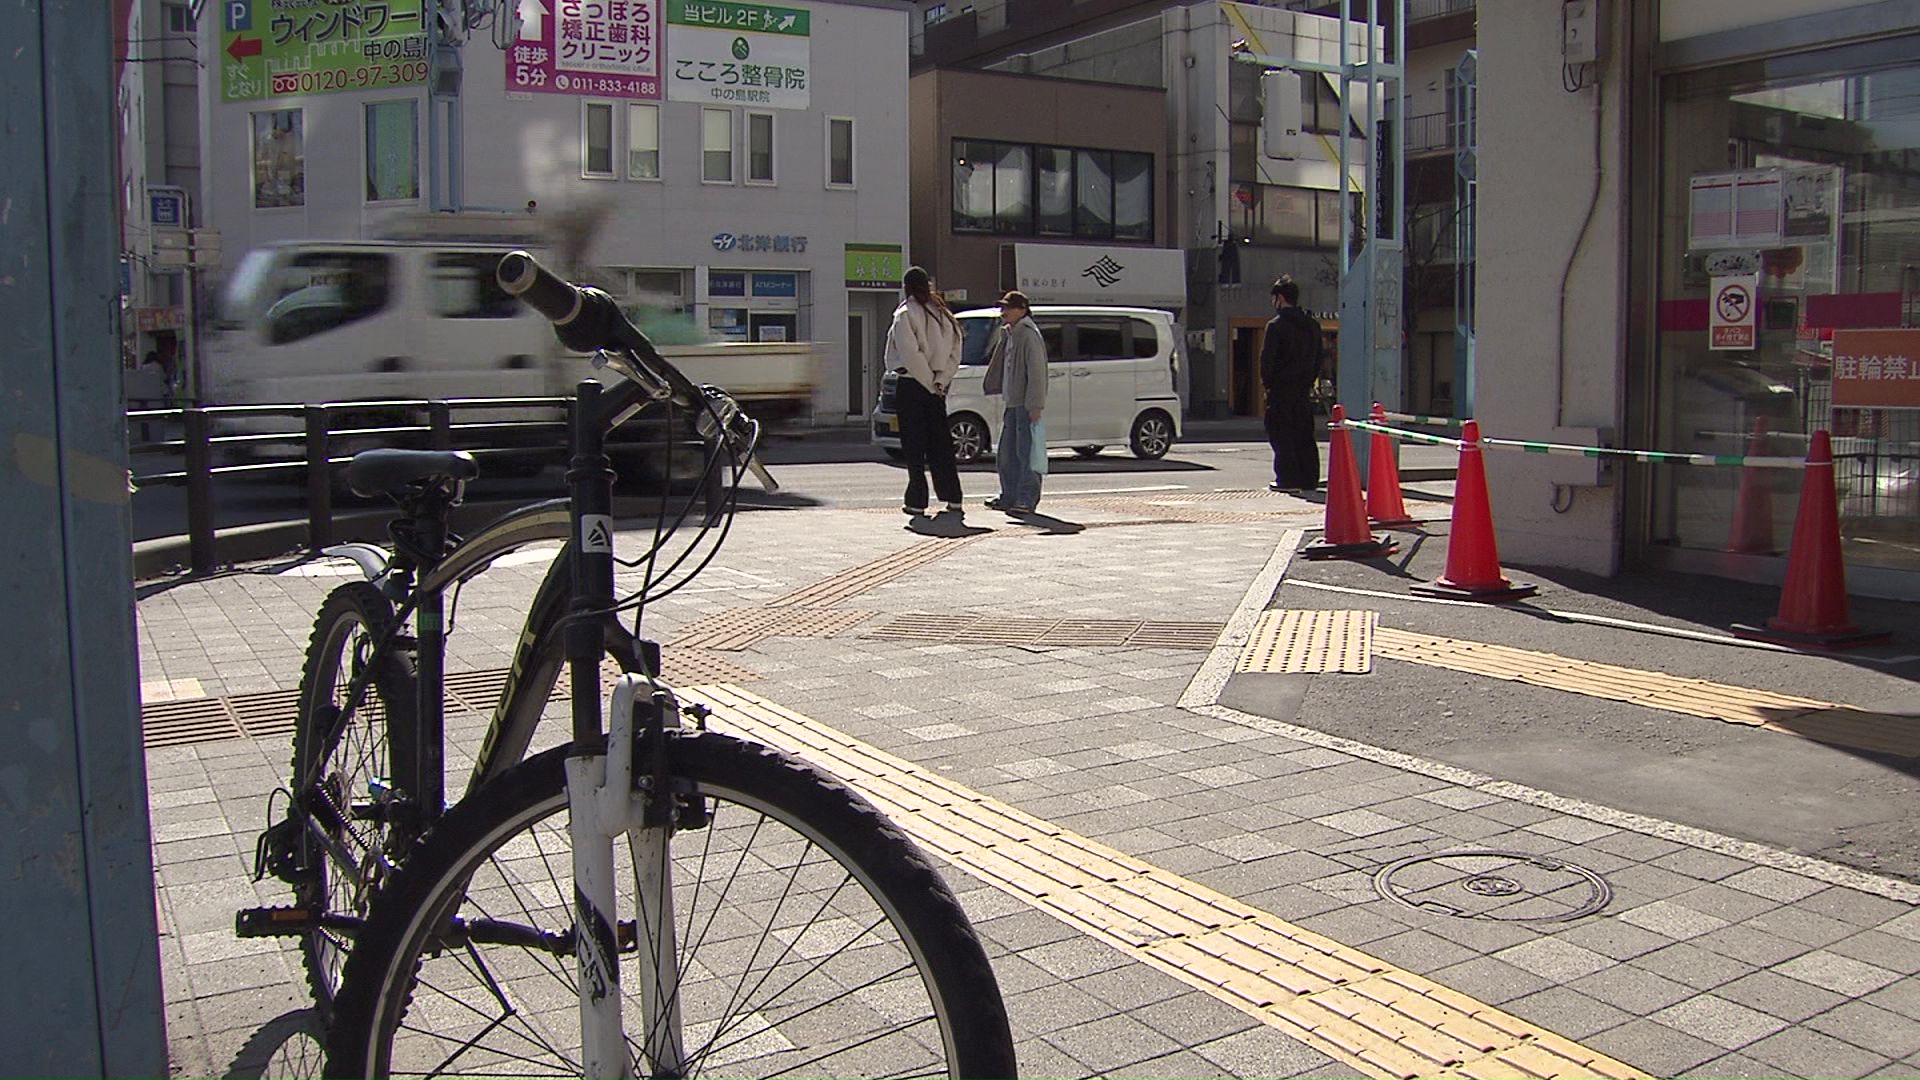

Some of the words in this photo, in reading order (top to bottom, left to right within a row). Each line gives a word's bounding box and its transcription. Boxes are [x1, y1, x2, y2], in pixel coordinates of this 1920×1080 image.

[231, 3, 246, 30] P
[561, 0, 650, 23] さっぽろ
[684, 4, 732, 23] 当ビル
[736, 10, 758, 26] 2F
[561, 18, 651, 46] 矯正歯科
[514, 45, 549, 64] 徒歩
[561, 41, 650, 64] クリニック
[515, 65, 548, 86] 5分
[572, 77, 656, 94] 011-833-4188
[675, 60, 805, 90] こころ整骨院
[738, 234, 808, 253] 北洋銀行
